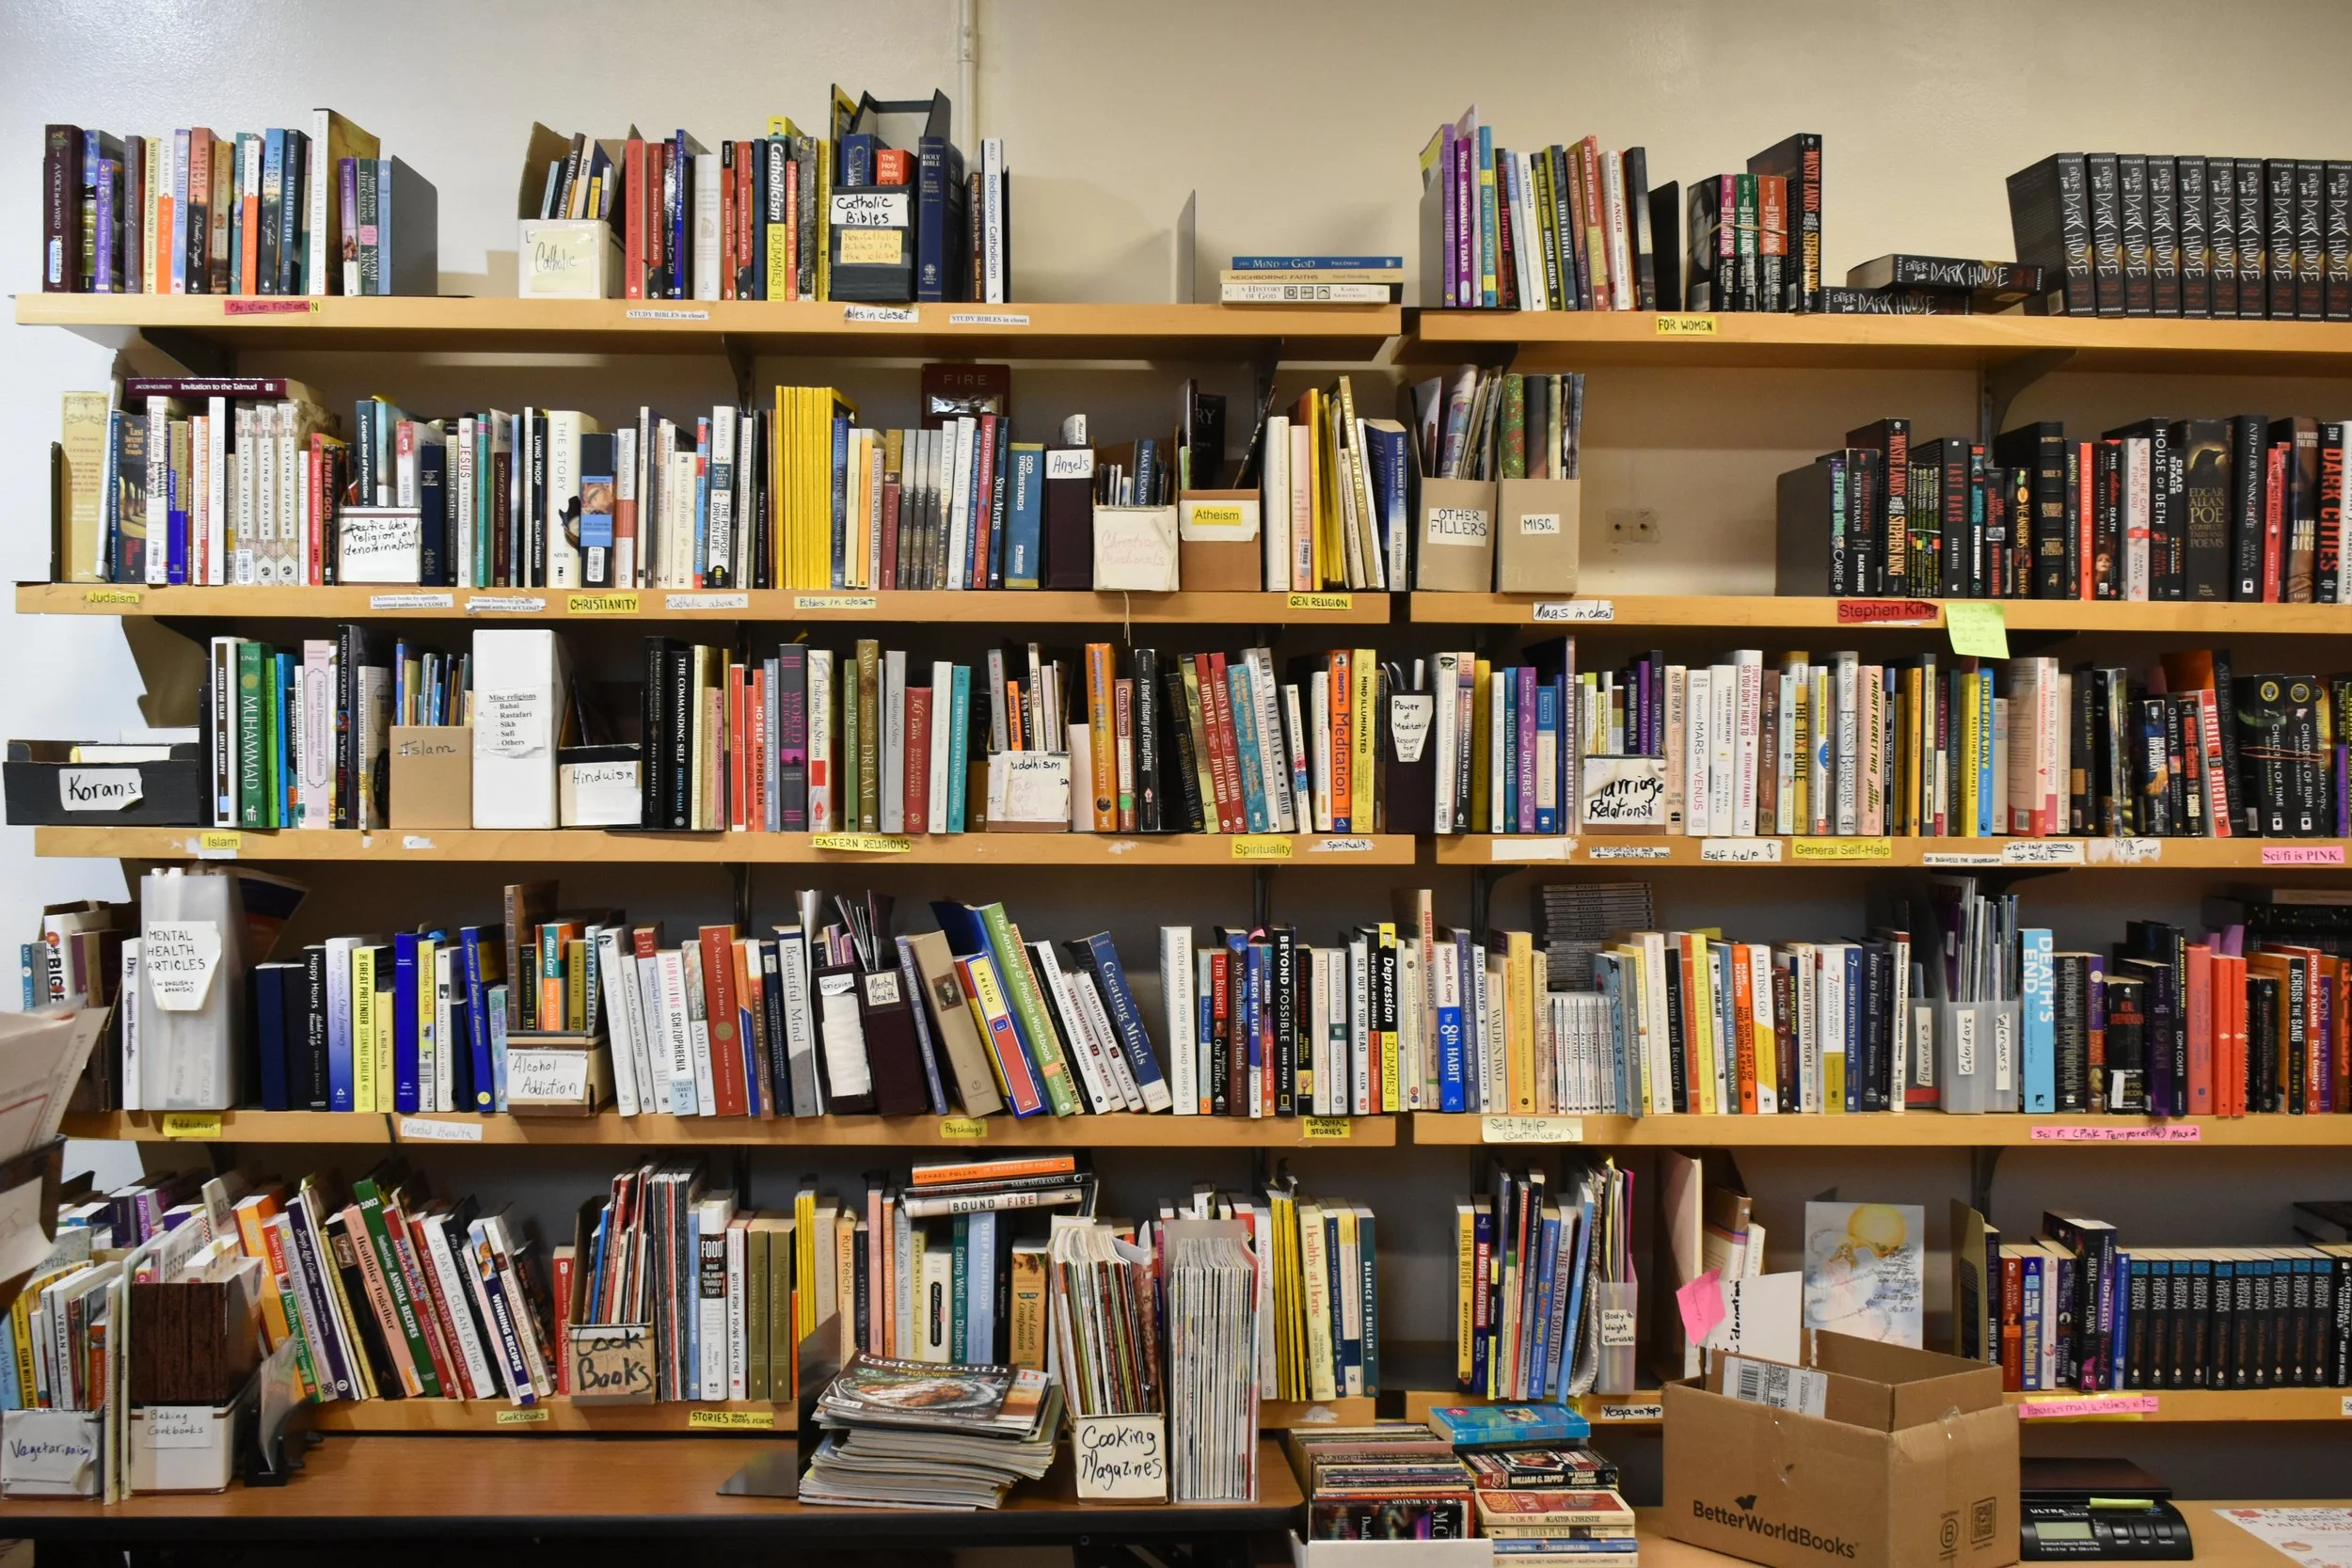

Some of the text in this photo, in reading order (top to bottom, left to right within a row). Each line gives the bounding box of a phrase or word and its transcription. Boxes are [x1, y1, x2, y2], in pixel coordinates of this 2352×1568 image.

[771, 143, 783, 221] Catholicism
[836, 197, 893, 210] Catholic
[847, 211, 889, 224] Bibles
[988, 174, 997, 279] Rediscover Catholicism
[2063, 166, 2088, 278] ENTER DARK HOUSE
[534, 242, 578, 272] Catholic
[771, 234, 783, 286] DUMMIES
[1253, 260, 1279, 268] MIND
[1292, 260, 1315, 268] GOD
[1905, 261, 1930, 274] ENTER
[1930, 261, 1965, 282] DARK
[1968, 267, 2009, 287] HOUSE
[230, 302, 309, 311] Christian Fiction
[880, 309, 912, 320] closet
[1658, 319, 1713, 331] FOR WOMEN
[944, 375, 987, 385] FIRE
[460, 444, 470, 478] JESUS
[1054, 455, 1089, 473] Angels
[1017, 455, 1025, 511] UNDERSTANDS
[2189, 488, 2224, 498] EDGAR
[2190, 498, 2225, 506] ALLAN
[1195, 509, 1239, 521] Atheism
[1438, 510, 1480, 522] OTHER
[2189, 508, 2224, 523] POE
[2320, 449, 2343, 572] DARK CITIES
[1431, 522, 1487, 536] FILLERS
[1524, 519, 1555, 531] MISC.
[353, 531, 395, 542] religion
[720, 517, 728, 559] PURPOSE
[344, 541, 415, 555] denomination
[90, 592, 136, 603] Judaism
[570, 598, 637, 610] CHRISTIANITY
[1311, 596, 1347, 608] RELIGION
[1839, 602, 1938, 619] Stephen King
[677, 678, 686, 740] COMMANDING
[1394, 702, 1419, 710] Power
[1694, 719, 1705, 753] MARS
[2168, 707, 2179, 752] ORBITAL
[243, 694, 260, 790] MUHAMMAD
[396, 740, 456, 756] Islam
[1795, 702, 1806, 783] THE 10X RULE
[676, 743, 685, 764] SELF
[1336, 713, 1349, 797] Meditation
[2203, 705, 2227, 819] MICHAEL CRICHTON
[573, 769, 634, 784] Hinduism
[68, 777, 135, 800] Korans
[1694, 771, 1704, 811] VENUS
[208, 837, 237, 847] Islam
[816, 838, 910, 849] EASTERN RELIGIONS
[1235, 844, 1291, 856] Spirituality
[1795, 844, 1889, 856] General Self-Help
[1732, 849, 1758, 861] help
[2264, 850, 2341, 862] Sci/fi is PINK.
[149, 930, 193, 942] MENTAL
[148, 945, 195, 957] HEALTH
[148, 959, 205, 971] ARTICLES
[2024, 948, 2039, 994] END
[995, 912, 1005, 929] The
[1001, 934, 1019, 968] Anxiety
[1019, 981, 1034, 1013] Phobia
[1030, 1013, 1053, 1062] Workbook
[1215, 958, 1227, 1015] Tim Russert
[1279, 936, 1290, 1042] BEYOND POSSIBLE
[2038, 937, 2055, 1023] DEATH'S
[1383, 957, 1394, 1023] Depression
[2310, 955, 2318, 1027] DOUGLAS ADAMS
[666, 957, 686, 1071] SURVIVING SCHIZOPHRENIA
[1104, 961, 1145, 1066] Creating Minds
[1962, 1016, 1973, 1072] Calendars
[1440, 1025, 1459, 1084] 8th HABIT
[1919, 1024, 1930, 1084] Planners
[513, 1056, 556, 1072] Alcohol
[1385, 1038, 1396, 1095] DUMMIES
[521, 1080, 577, 1096] Addiction
[172, 1118, 215, 1130] Addiction
[945, 1123, 982, 1135] Psychology
[360, 1197, 378, 1210] 2003
[953, 1196, 1035, 1212] BOUND FIRE
[701, 1239, 723, 1258] FOOD
[956, 1246, 966, 1277] Eating
[1306, 1224, 1322, 1318] Healthy at Home
[956, 1279, 964, 1298] Well
[1477, 1243, 1487, 1327] NO MORE HEARTBURN
[1605, 1312, 1625, 1321] Body
[492, 1293, 522, 1372] WINNING RECIPES
[955, 1320, 964, 1360] Diabetes
[576, 1328, 644, 1357] Cook
[577, 1357, 653, 1394] Books
[151, 1410, 187, 1424] Baking
[499, 1411, 545, 1422] Cookbooks
[691, 1412, 729, 1423] STORIES
[1604, 1408, 1631, 1418] Yoga
[148, 1425, 204, 1436] Cookbooks
[1082, 1425, 1156, 1456] Cooking
[1082, 1450, 1164, 1491] Magazines
[1544, 1515, 1567, 1524] AGATHA
[1692, 1500, 1856, 1560] BetterWorldBooks
